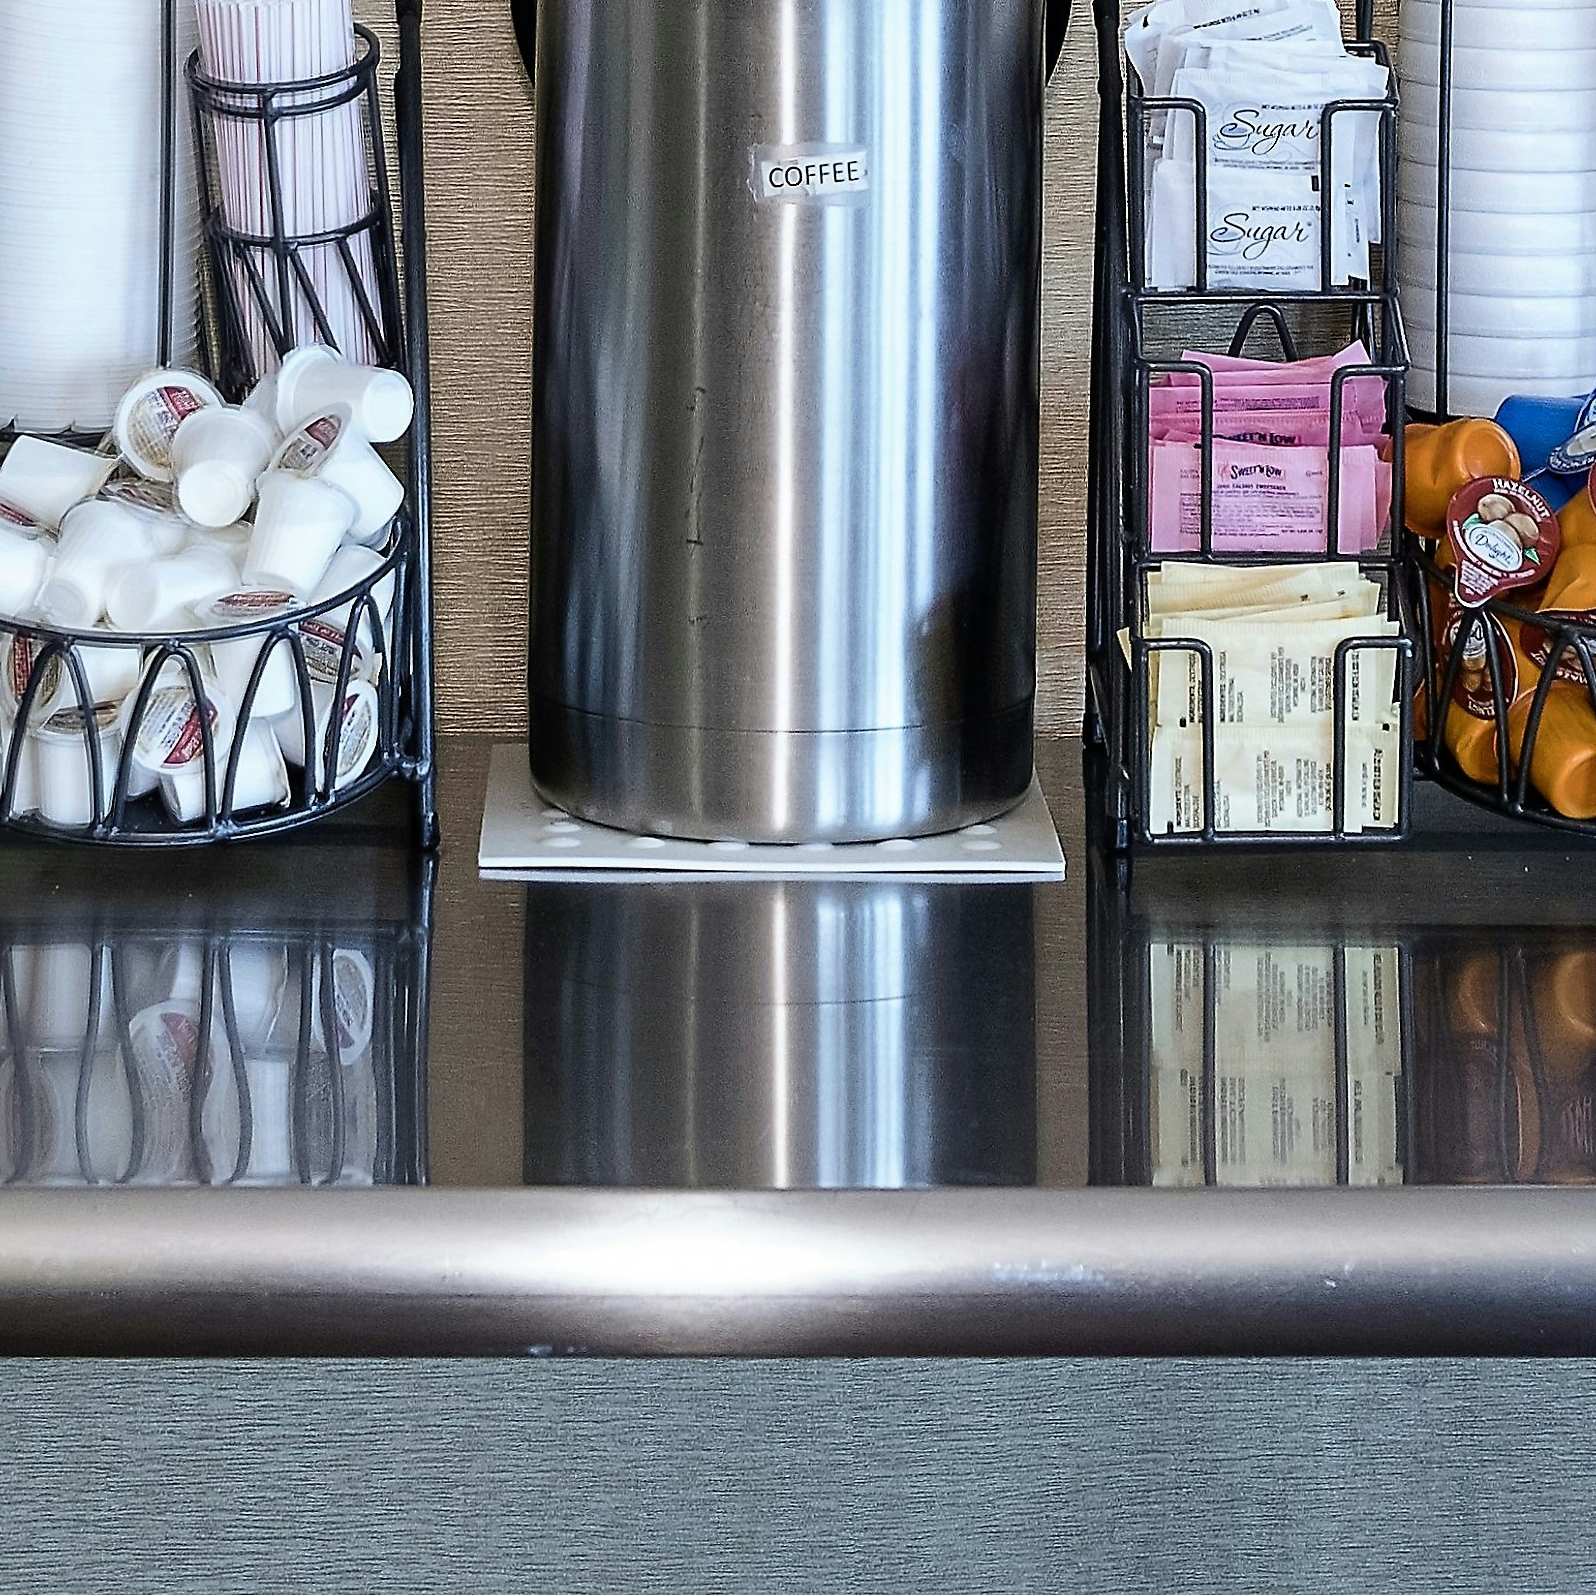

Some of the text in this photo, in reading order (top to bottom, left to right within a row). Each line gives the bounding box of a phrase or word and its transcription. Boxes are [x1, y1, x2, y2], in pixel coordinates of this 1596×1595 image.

[1219, 109, 1319, 156] Sugar
[768, 161, 860, 188] COFFEE
[1209, 212, 1310, 261] Sugar
[1492, 478, 1551, 519] HAZELNUT
